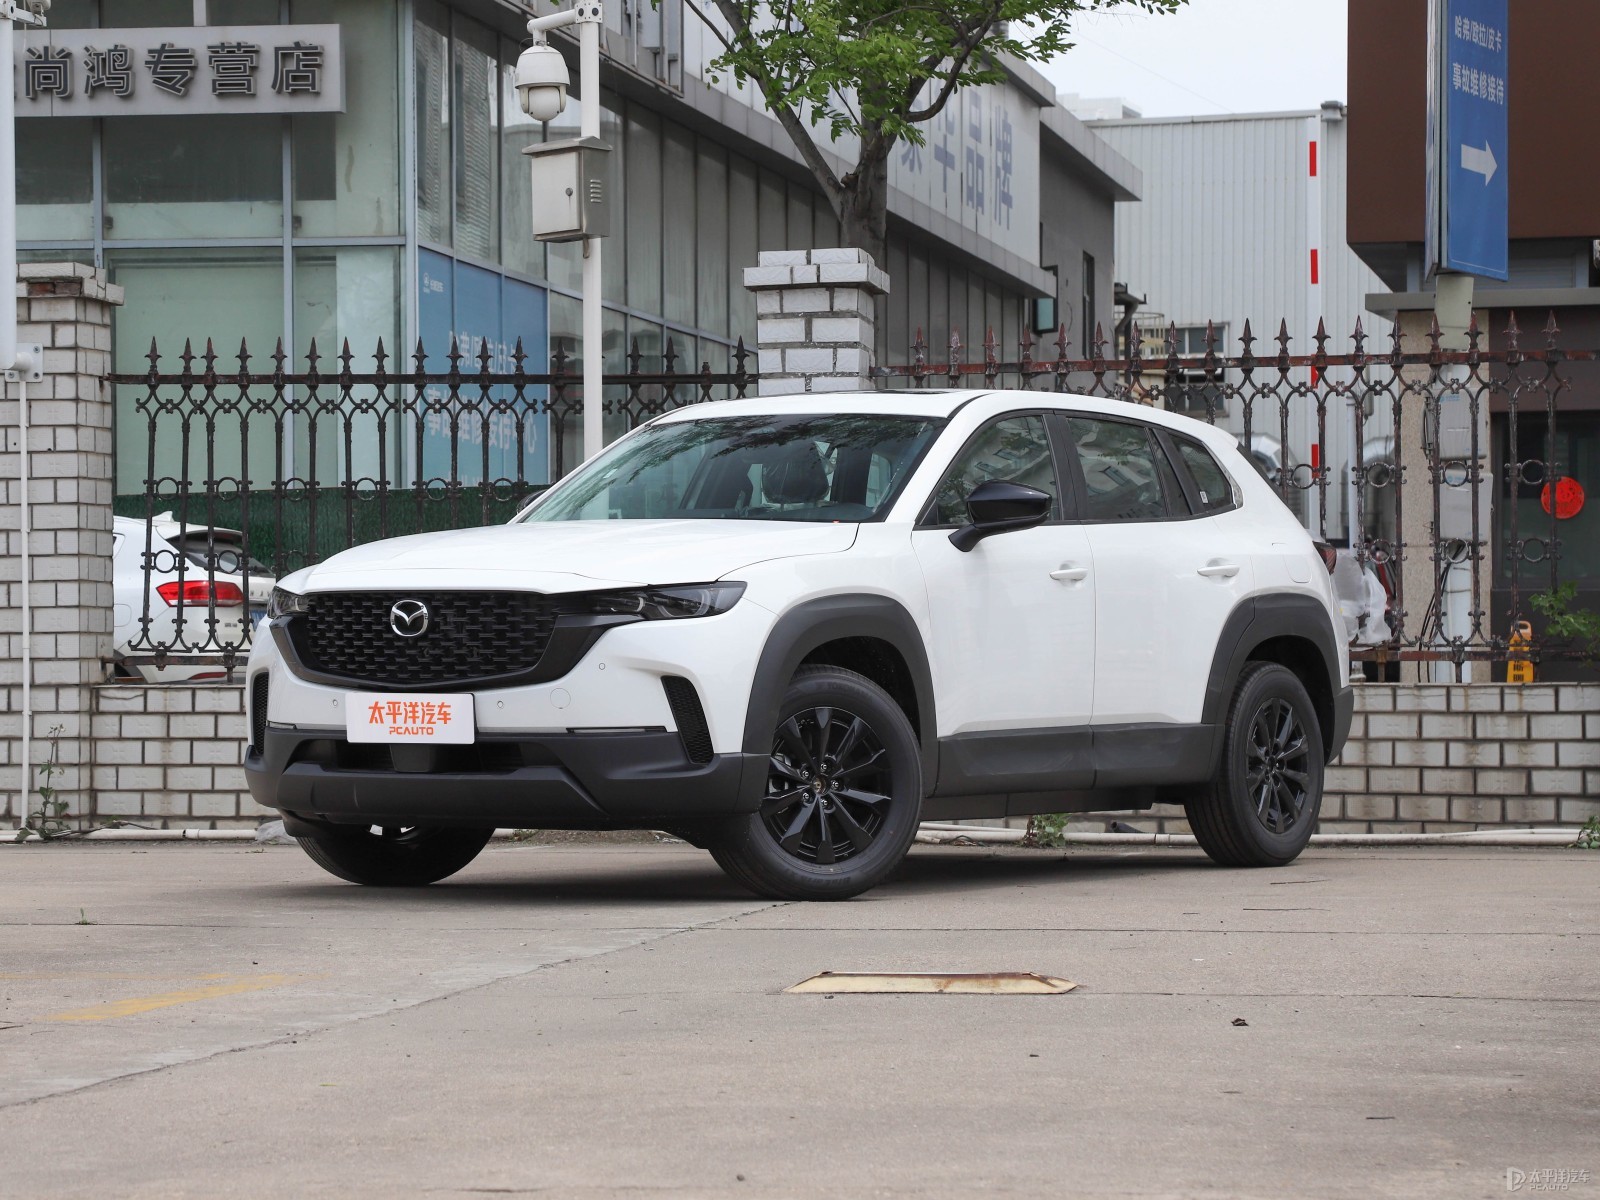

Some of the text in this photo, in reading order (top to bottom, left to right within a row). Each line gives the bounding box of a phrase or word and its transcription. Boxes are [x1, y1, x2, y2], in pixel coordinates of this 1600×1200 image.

[25, 41, 323, 98] 尚鸿专营店
[1452, 62, 1504, 105] 事故维修接待
[368, 701, 452, 725] 太平洋汽车
[389, 726, 434, 736] PCAUTO
